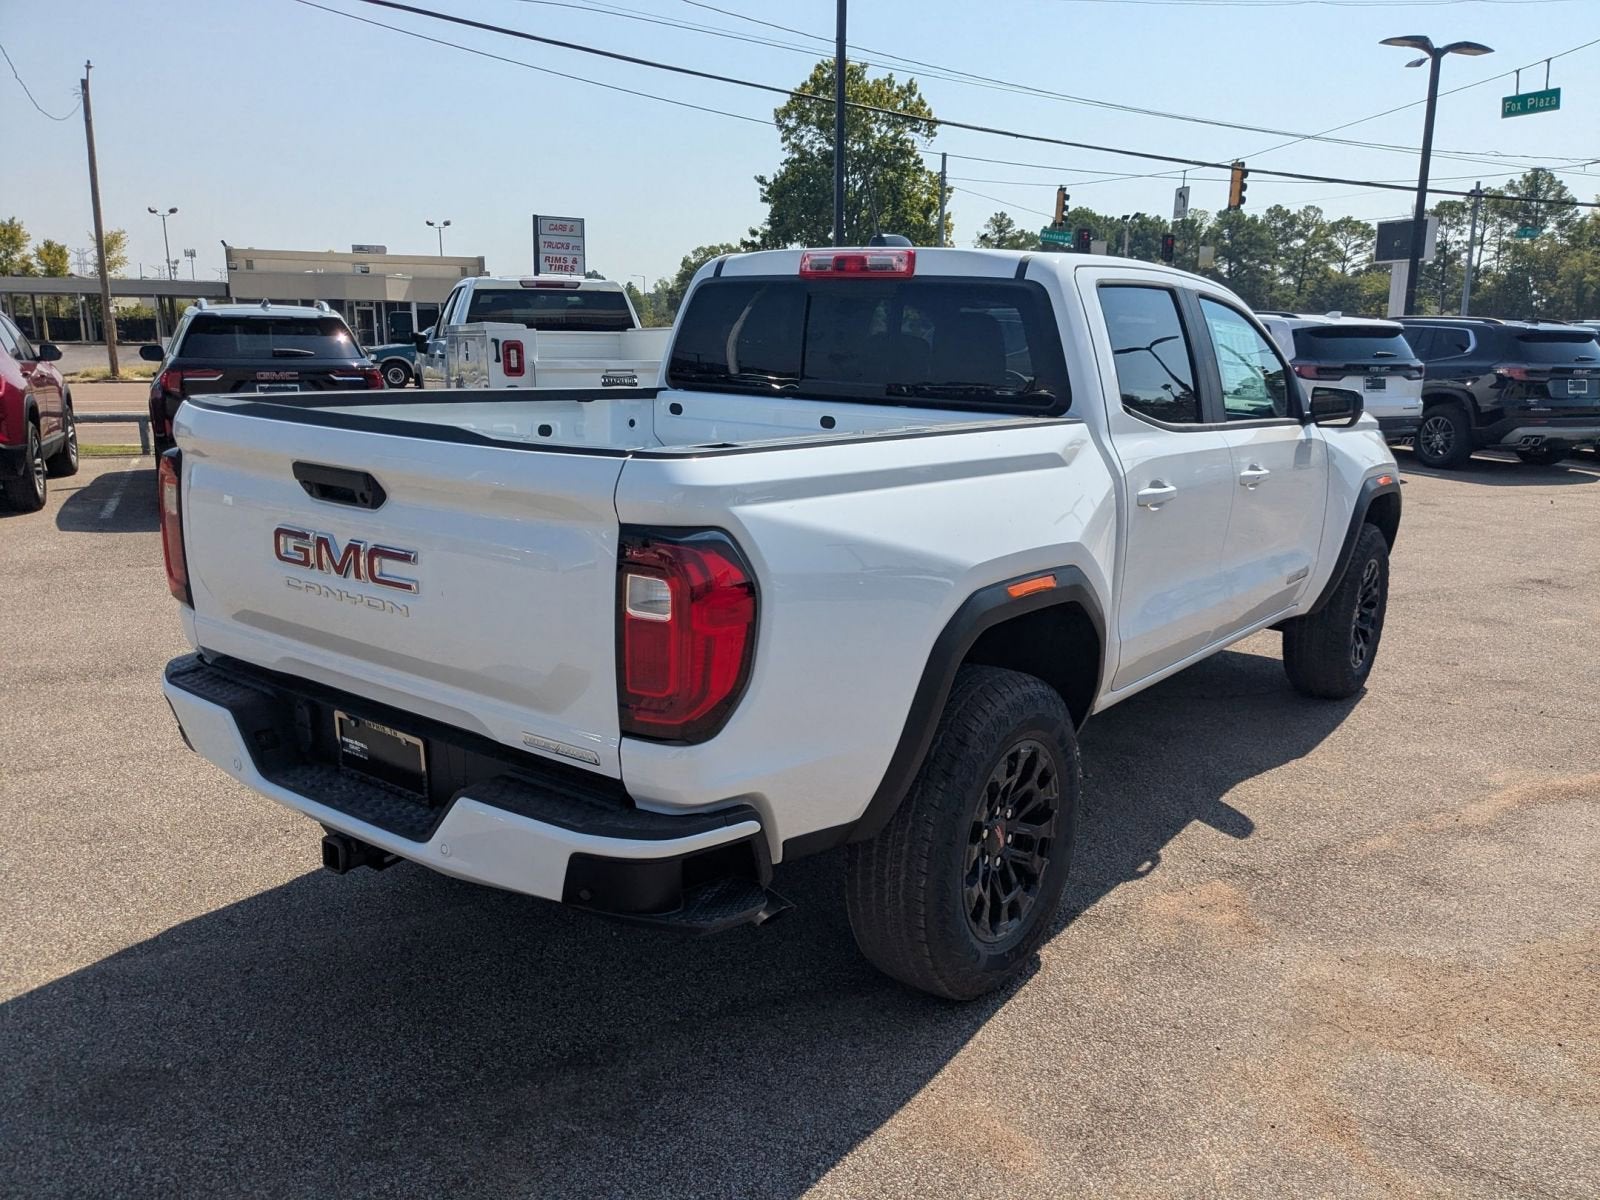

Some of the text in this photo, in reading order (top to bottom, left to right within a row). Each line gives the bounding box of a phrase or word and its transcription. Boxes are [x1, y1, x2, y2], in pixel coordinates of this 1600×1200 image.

[1505, 96, 1556, 112] Fox Plaza
[549, 224, 567, 232] CARS
[543, 241, 570, 250] TRUCKS
[544, 256, 568, 264] RIMS
[548, 264, 575, 272] TIRES
[256, 371, 299, 380] GMC
[274, 523, 419, 595] GMC
[285, 575, 410, 618] CANYON
